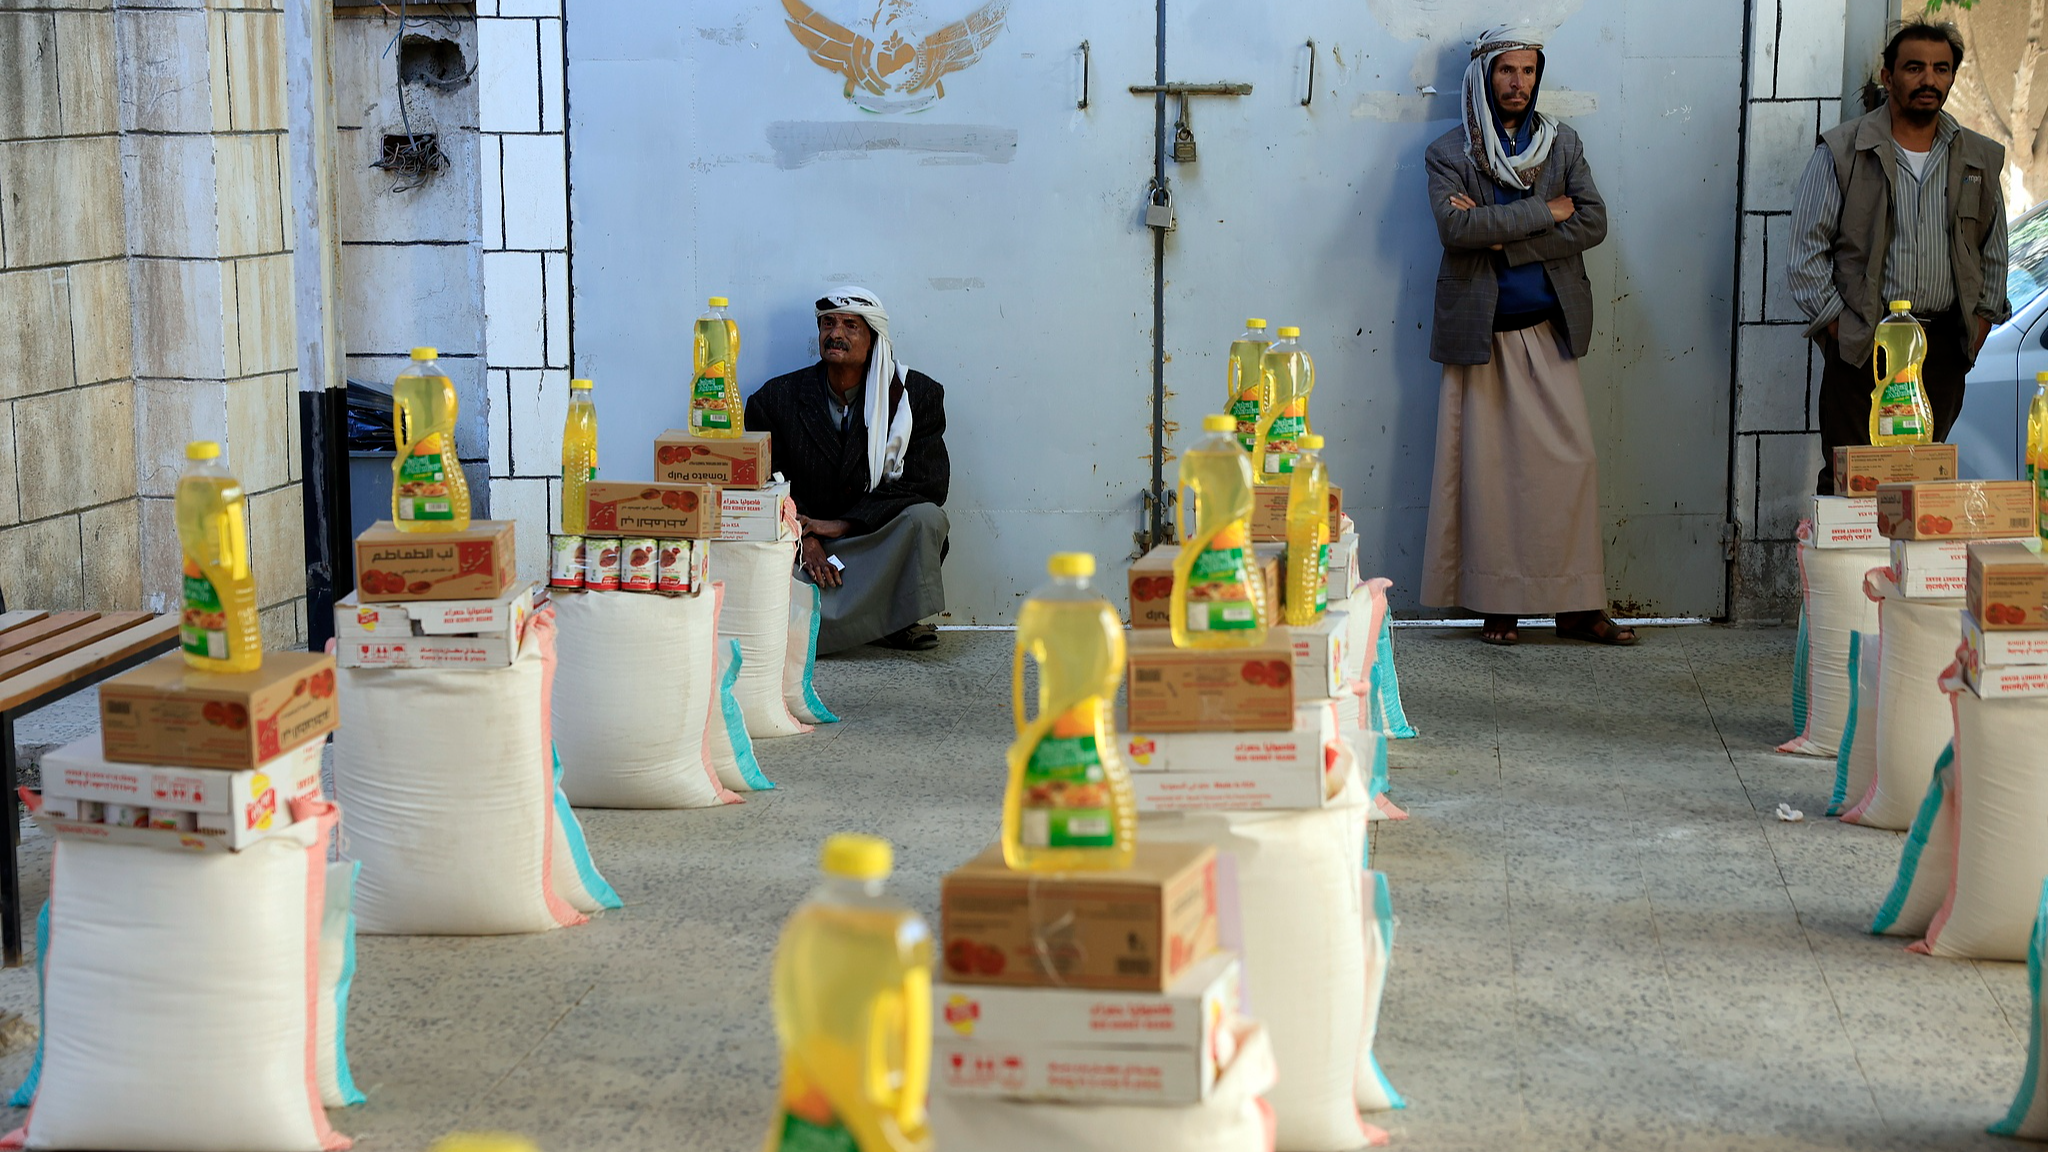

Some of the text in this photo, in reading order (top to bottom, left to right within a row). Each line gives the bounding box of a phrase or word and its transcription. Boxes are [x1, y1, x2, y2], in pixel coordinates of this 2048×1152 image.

[668, 470, 690, 481] Pulp
[691, 471, 729, 481] Tomato
[740, 498, 761, 506] فاصوليا
[621, 516, 635, 527] لب
[636, 517, 688, 528] الطماطم
[371, 548, 433, 564] الطماطم
[436, 547, 454, 561] لب
